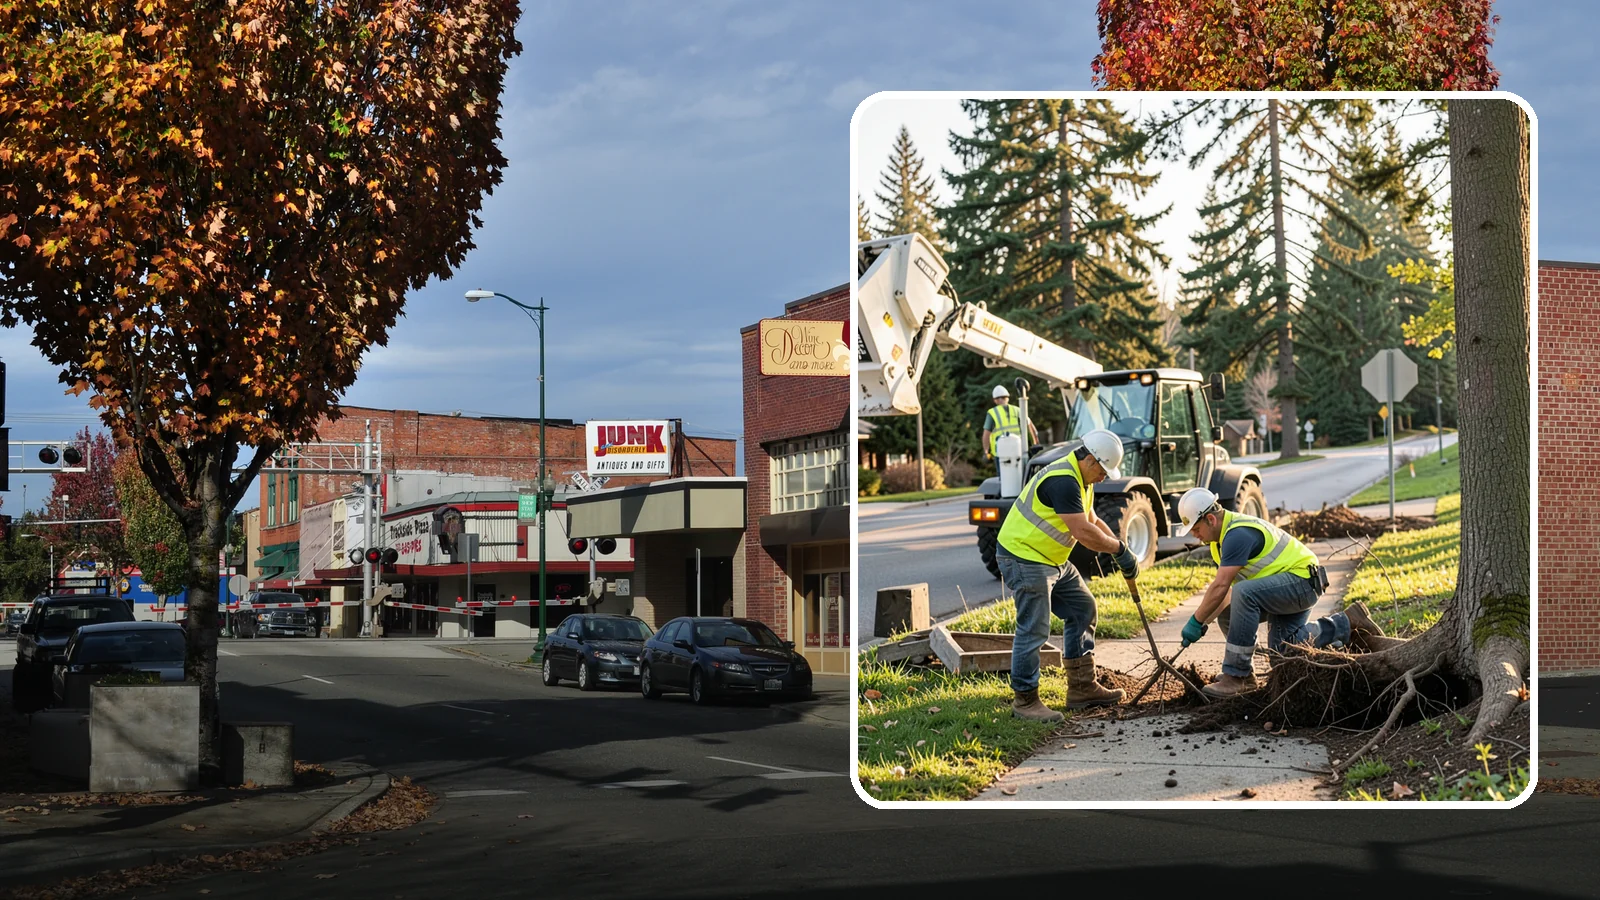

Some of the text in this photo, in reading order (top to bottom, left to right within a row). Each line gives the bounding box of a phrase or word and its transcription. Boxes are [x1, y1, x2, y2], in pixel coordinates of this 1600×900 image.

[764, 328, 831, 365] Decor
[596, 425, 665, 457] JUNK
[607, 446, 646, 454] DISORDERLY
[597, 460, 666, 470] ANTIQUES AND GIFTS
